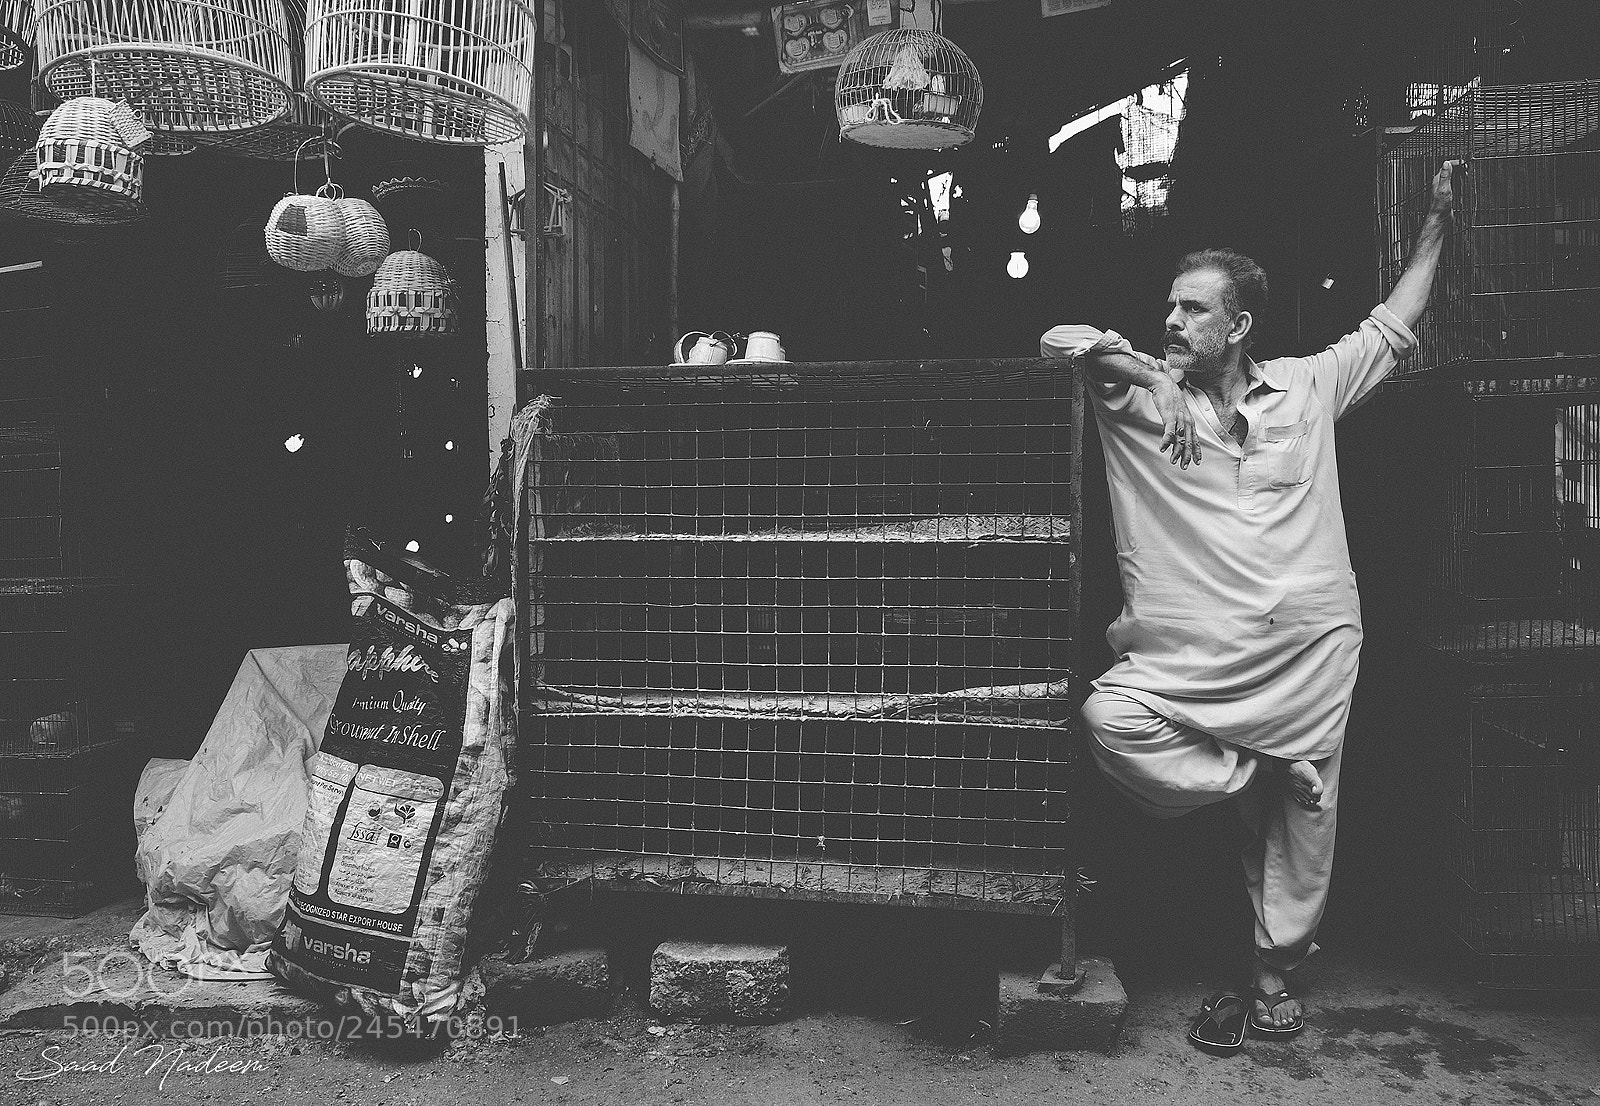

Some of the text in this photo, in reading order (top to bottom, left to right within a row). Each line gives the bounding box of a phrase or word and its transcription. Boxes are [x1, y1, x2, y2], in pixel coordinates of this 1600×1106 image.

[377, 603, 438, 644] varsha
[348, 645, 439, 683] apphire
[392, 689, 427, 716] Quaity
[398, 725, 447, 751] Shell
[298, 901, 404, 933] ECOGNIZED STAR EXPORT HOUSE
[303, 935, 371, 964] varsha
